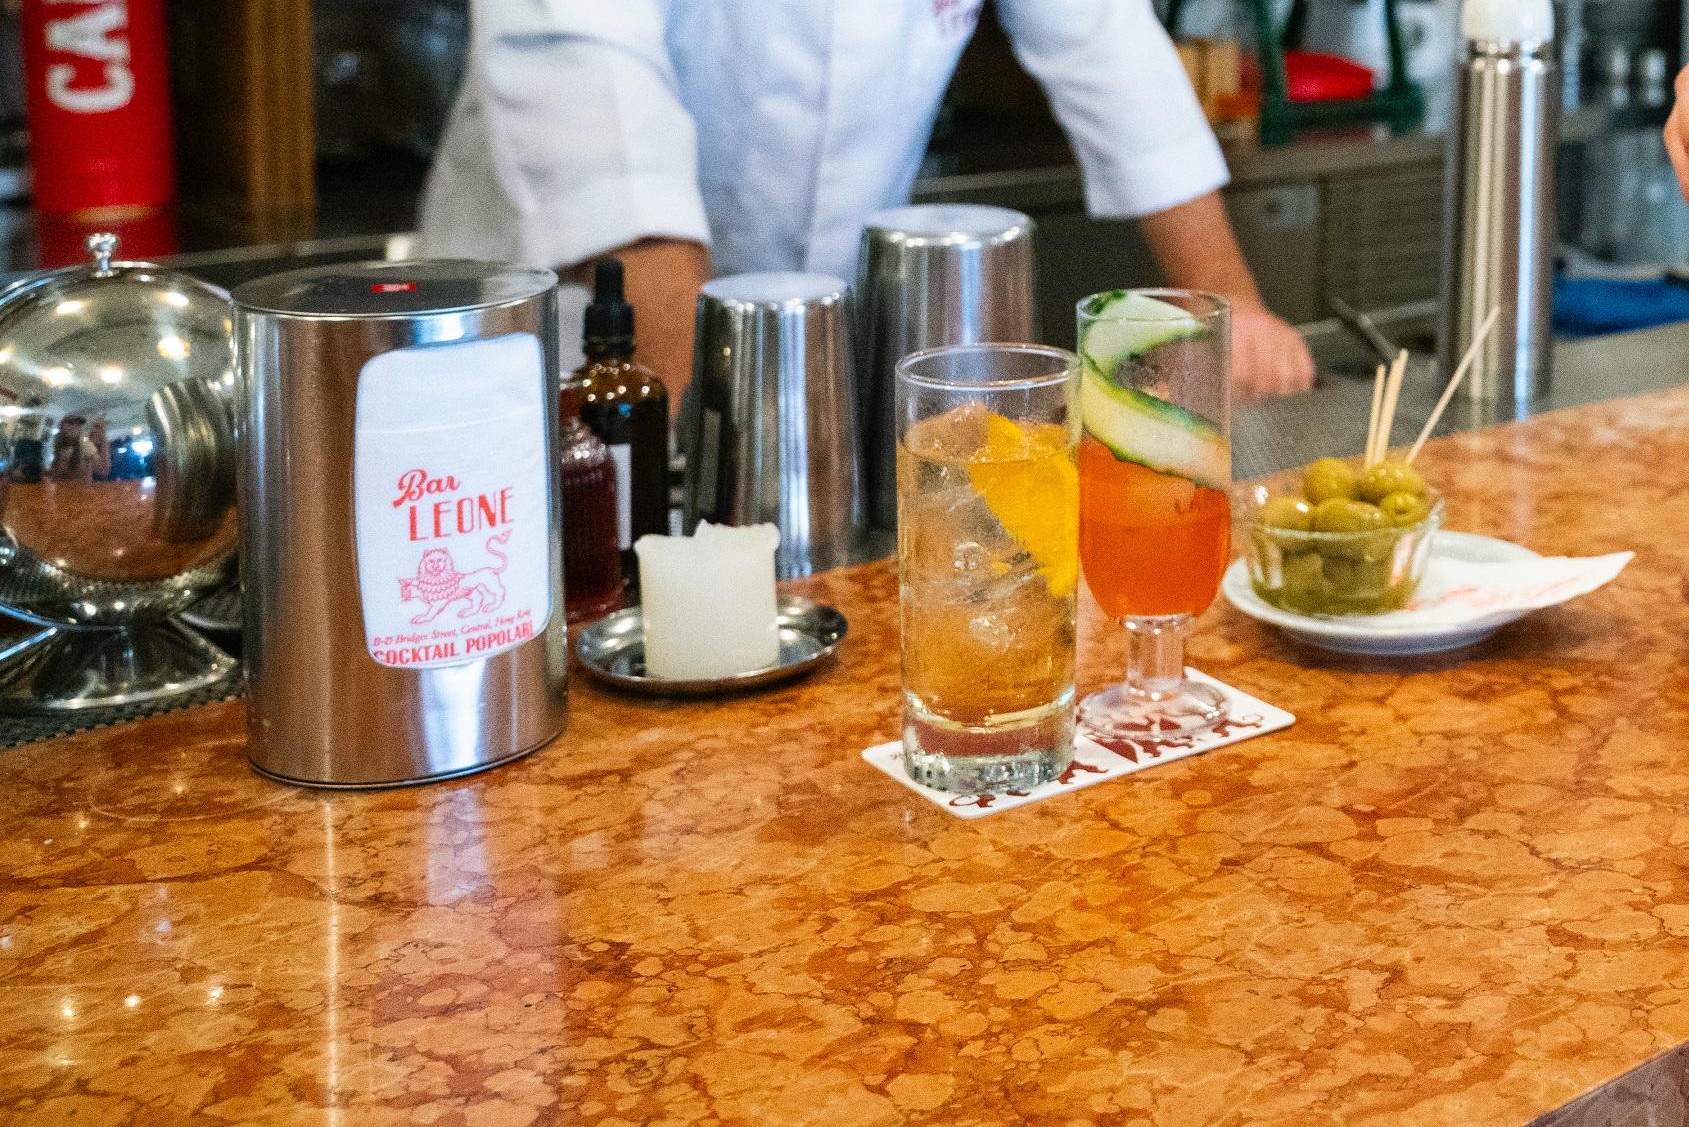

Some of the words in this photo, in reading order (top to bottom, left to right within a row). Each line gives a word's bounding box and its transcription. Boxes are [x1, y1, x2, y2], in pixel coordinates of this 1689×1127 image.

[392, 468, 461, 508] Bar
[409, 487, 514, 541] LEONE
[373, 642, 460, 665] COCKTAIL
